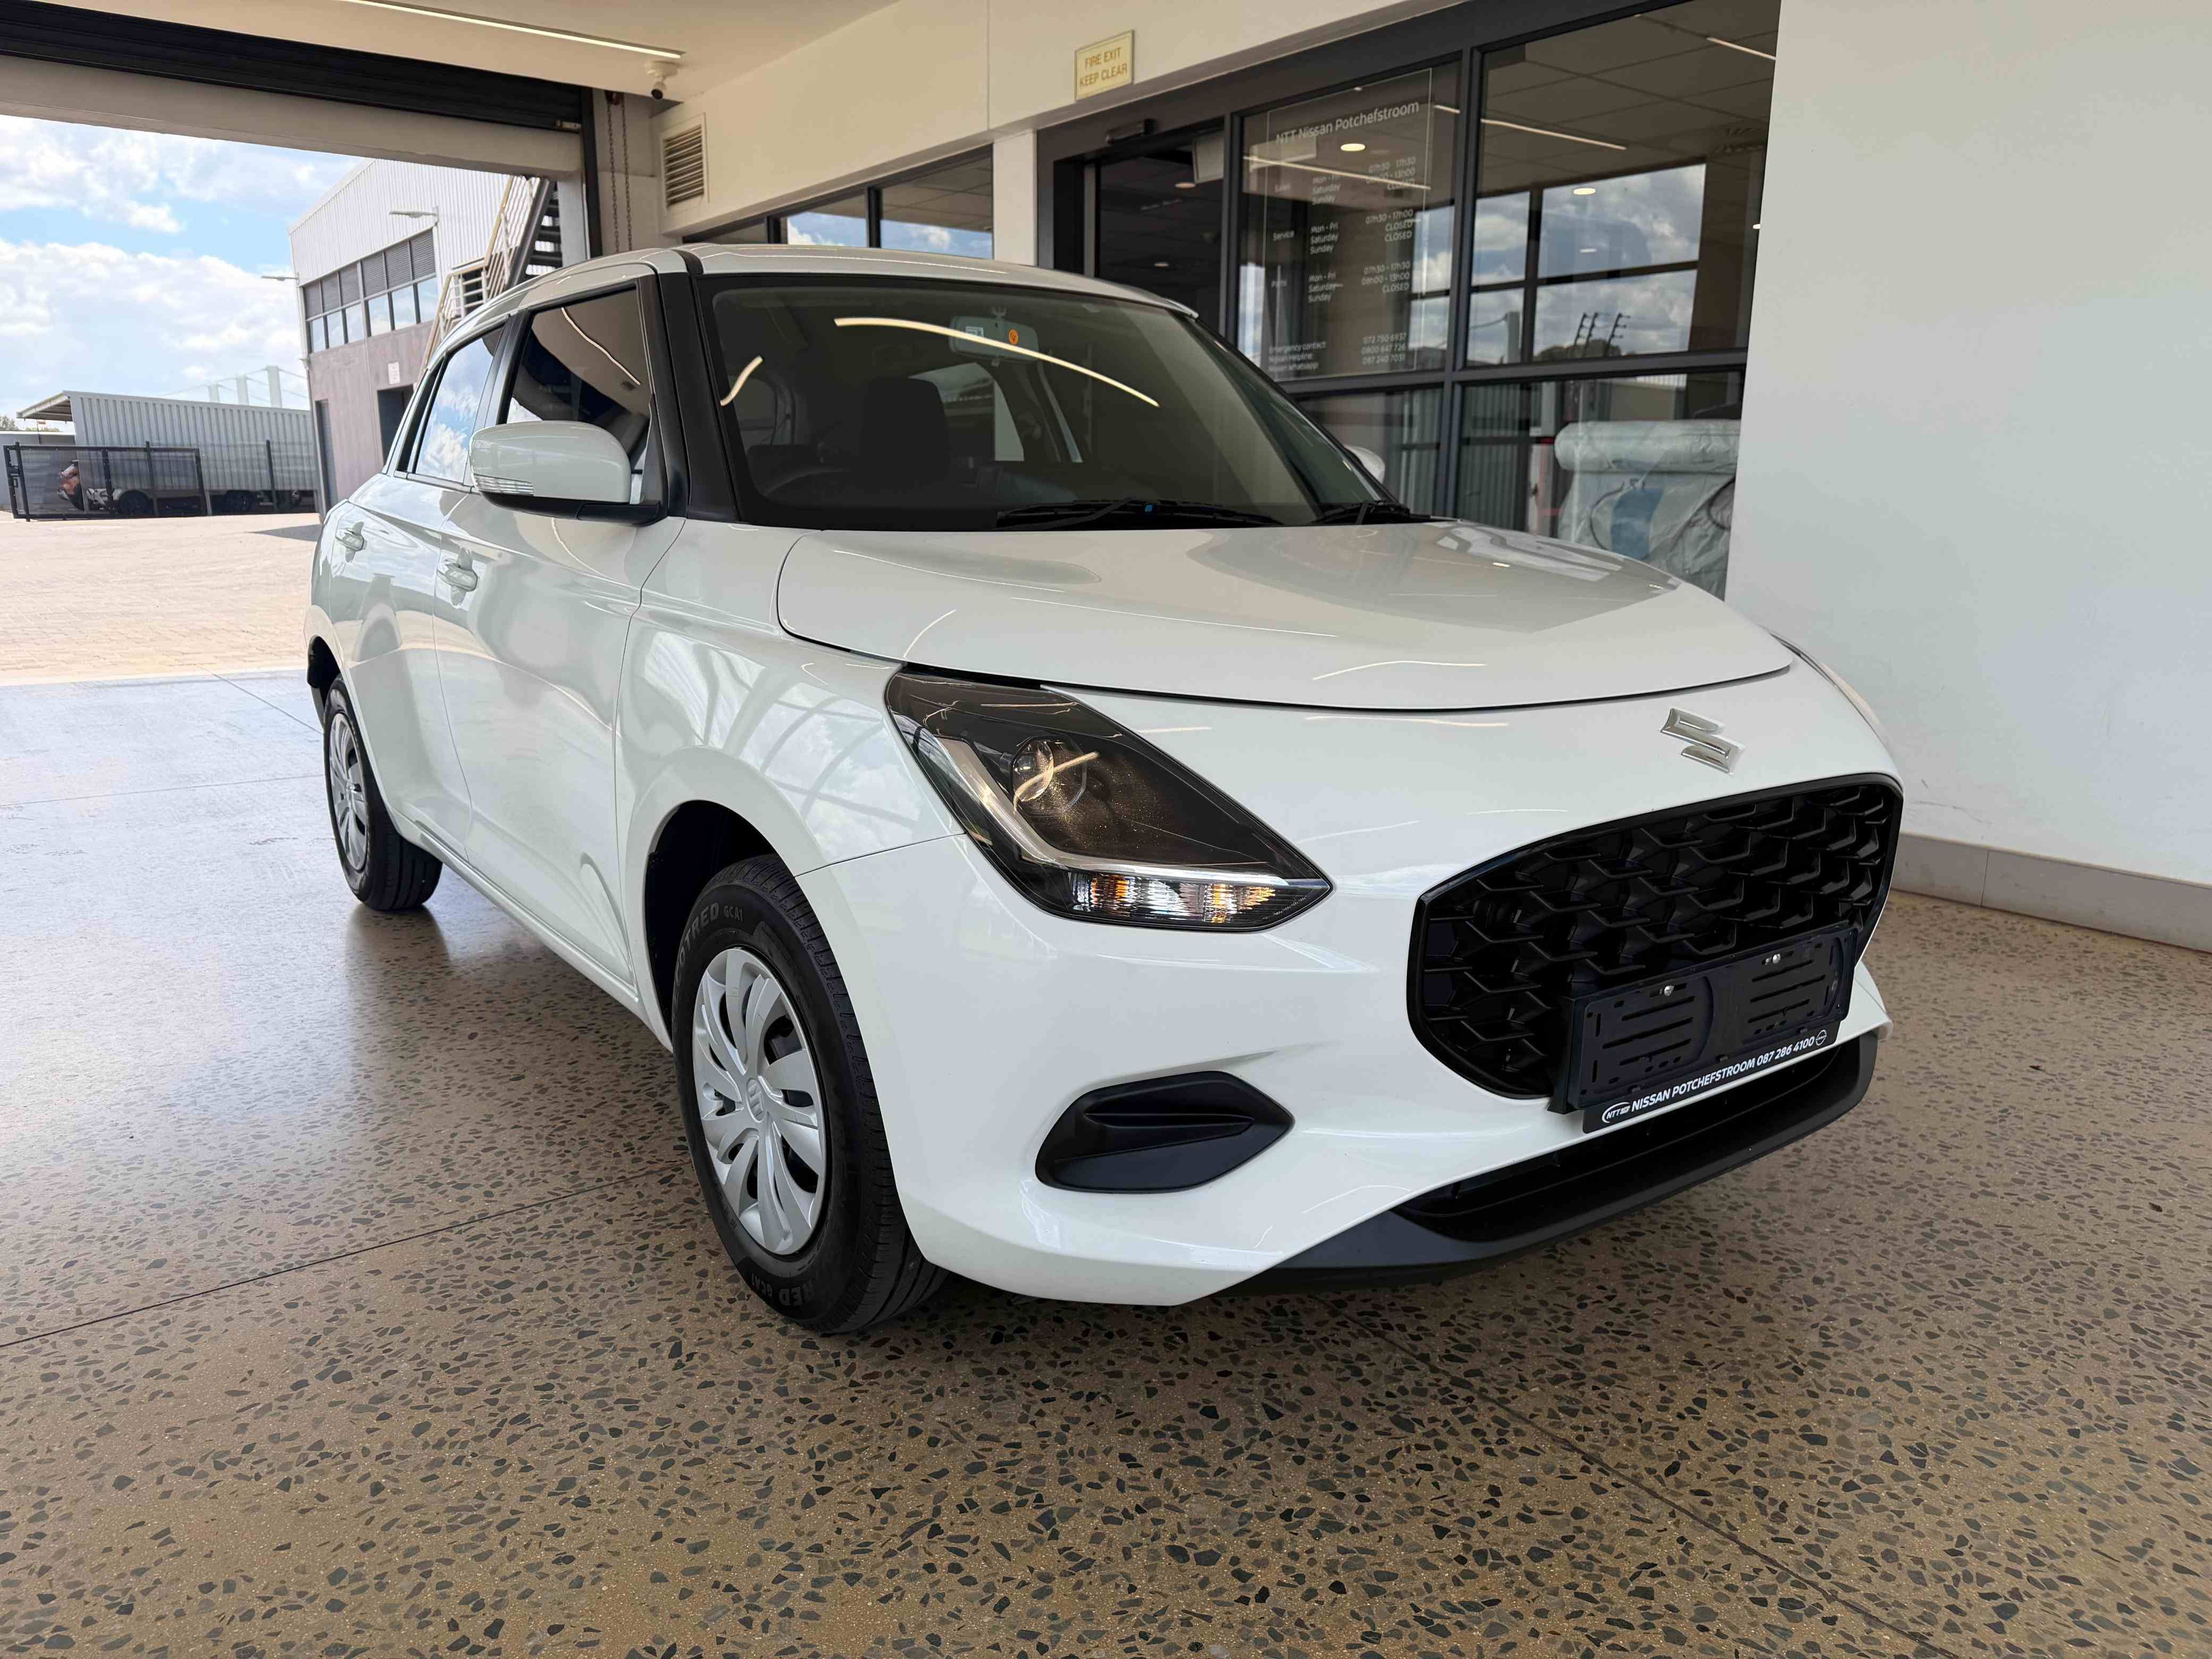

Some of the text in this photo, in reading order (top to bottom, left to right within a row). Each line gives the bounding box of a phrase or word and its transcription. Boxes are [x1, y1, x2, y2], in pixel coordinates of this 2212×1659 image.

[1085, 47, 1121, 69] FIRE EXIT
[1080, 63, 1127, 87] KEEP CLEAR
[1276, 102, 1419, 144] NTT Nissan Potchefstroom
[1385, 220, 1413, 232] CLOSED
[1273, 231, 1295, 240] Service
[1311, 233, 1340, 245] Saturday
[1385, 231, 1412, 242] CLOSED
[1310, 245, 1335, 254] Sunday
[1382, 282, 1410, 293] CLOSED
[723, 904, 743, 923] GCA1
[1631, 1088, 1671, 1112] NISSAN
[1672, 1057, 1755, 1097] POTCHEFSTROOM
[1756, 1051, 1774, 1066] 087
[1775, 1044, 1793, 1060] 286
[1793, 1036, 1815, 1052] 4100
[1606, 1108, 1622, 1119] NTT
